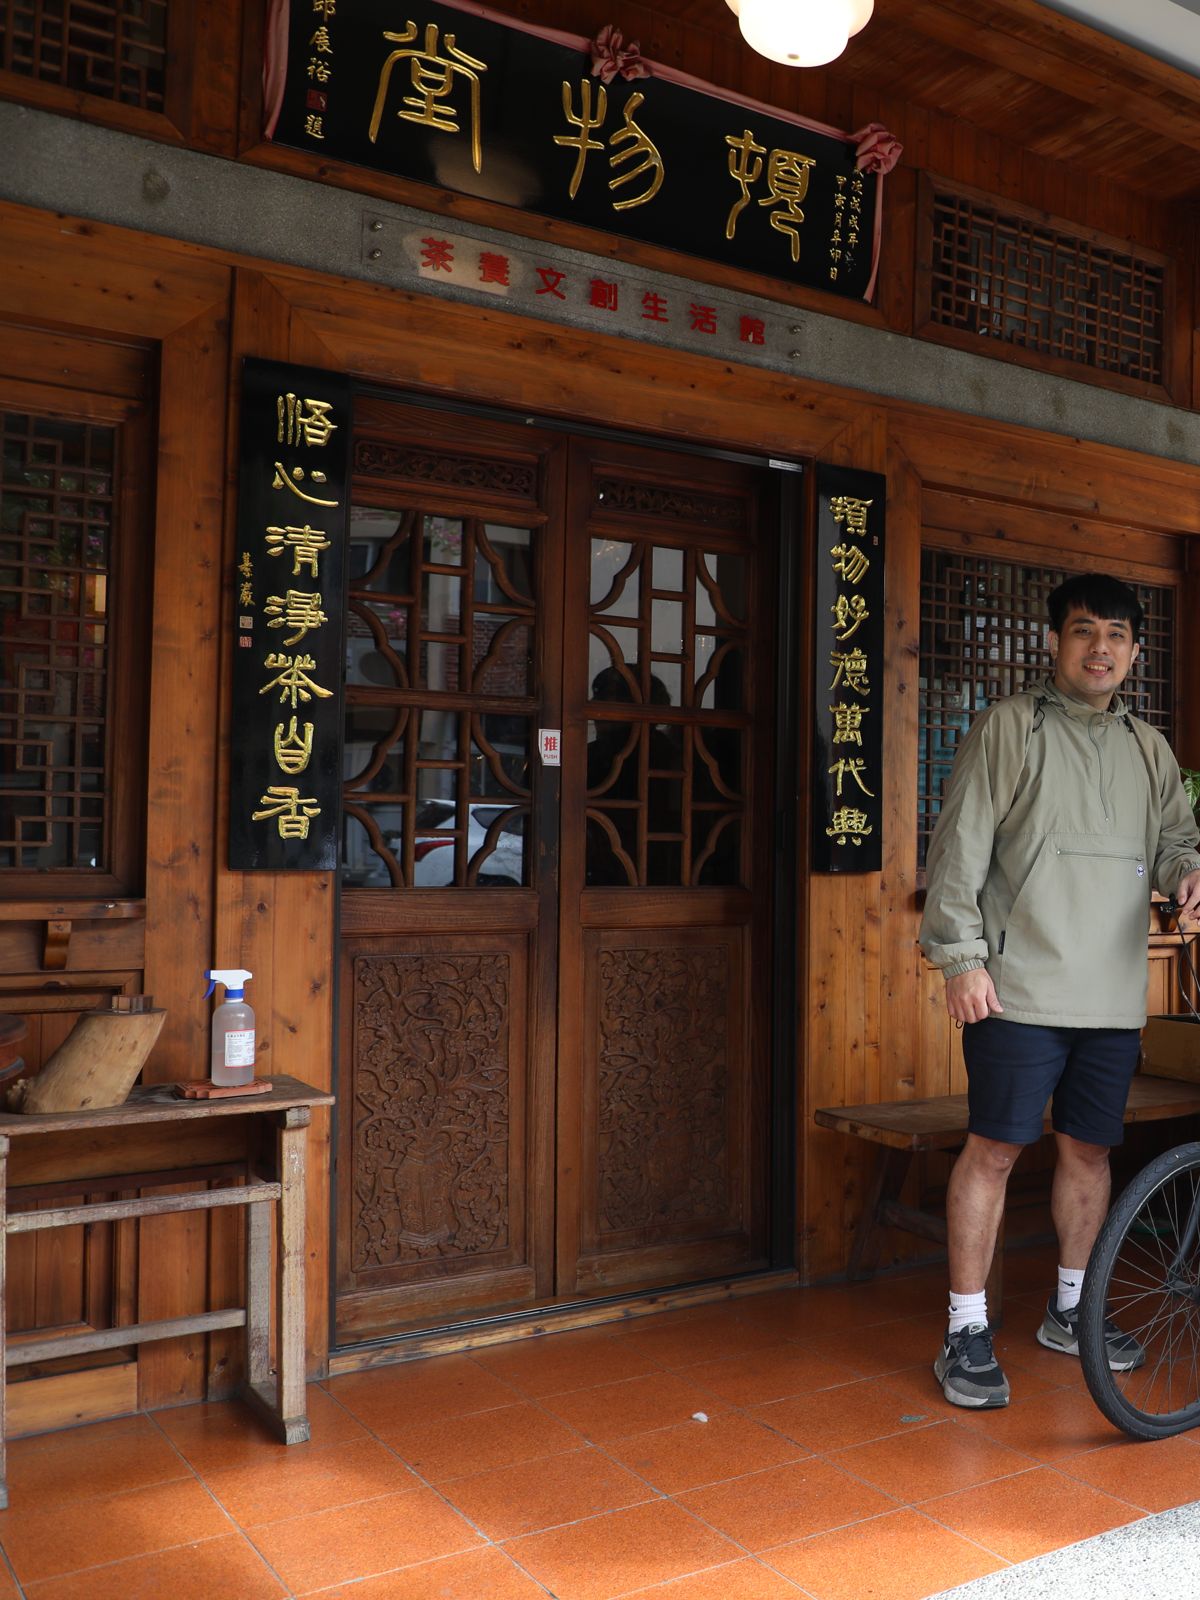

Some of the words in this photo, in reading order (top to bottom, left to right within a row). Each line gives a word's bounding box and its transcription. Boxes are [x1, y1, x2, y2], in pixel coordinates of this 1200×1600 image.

[420, 237, 766, 346] 茶養文創生活館
[544, 736, 558, 751] 推
